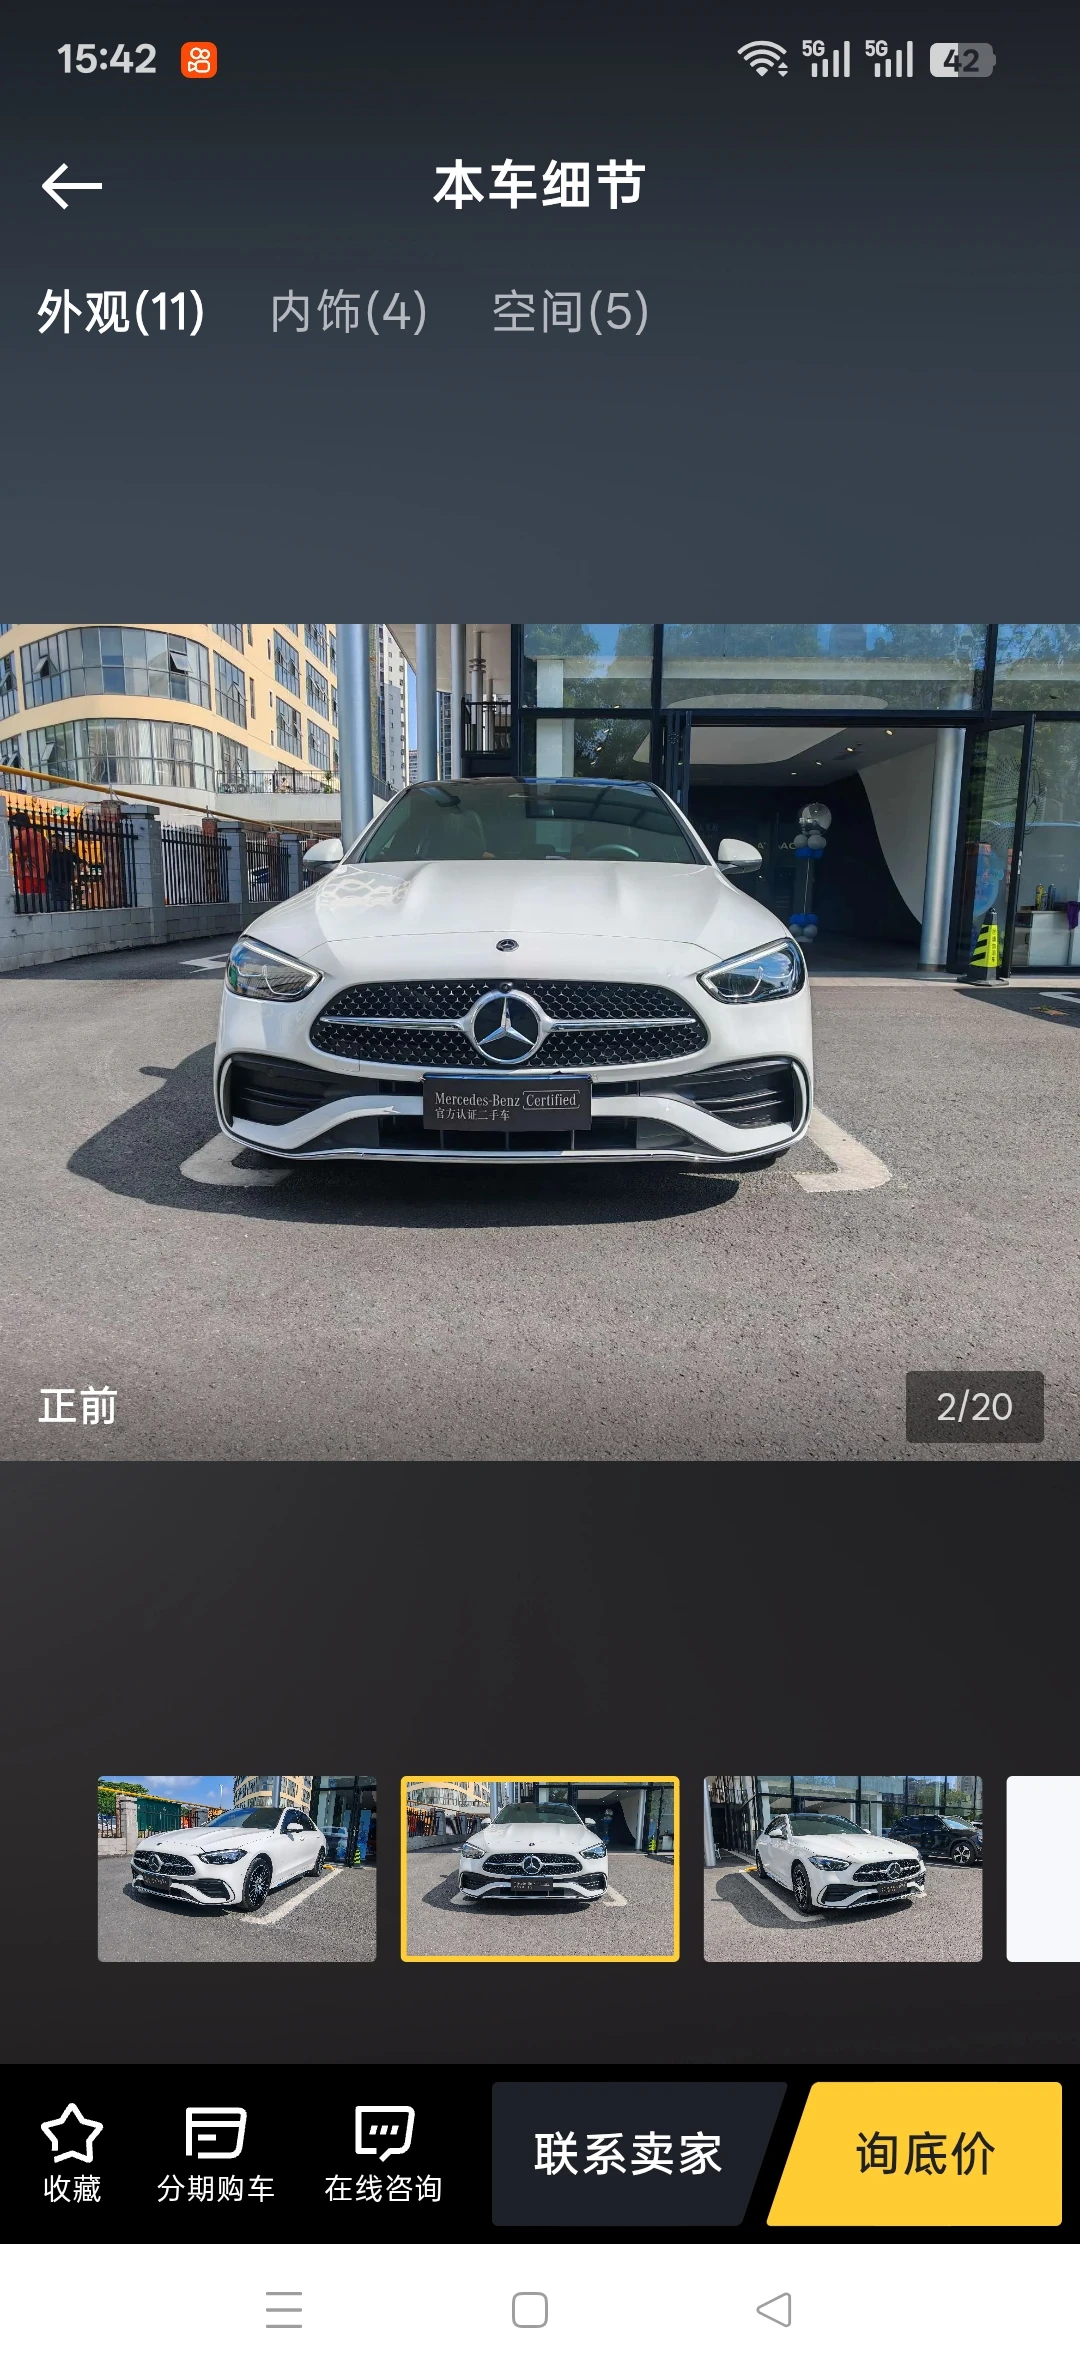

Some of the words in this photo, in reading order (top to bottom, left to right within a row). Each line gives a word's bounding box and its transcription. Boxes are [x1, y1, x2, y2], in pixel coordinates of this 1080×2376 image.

[57, 43, 157, 73] 15:42
[801, 39, 825, 57] 5G
[864, 39, 888, 57] 5G
[943, 49, 980, 72] 42
[432, 158, 646, 210] 本车细节
[36, 288, 204, 337] 外观(11)
[270, 288, 427, 336] 内饰(4)
[492, 288, 649, 336] 空间(5)
[434, 1092, 520, 1107] Mercedes-Benz
[526, 1093, 577, 1107] Certified
[434, 1107, 510, 1121] 官方认证二手车
[533, 2130, 723, 2177] 联系卖家
[855, 2130, 996, 2176] 询底价
[43, 2174, 102, 2204] 收藏
[156, 2174, 276, 2204] 分期购车
[324, 2174, 443, 2204] 在线咨询
